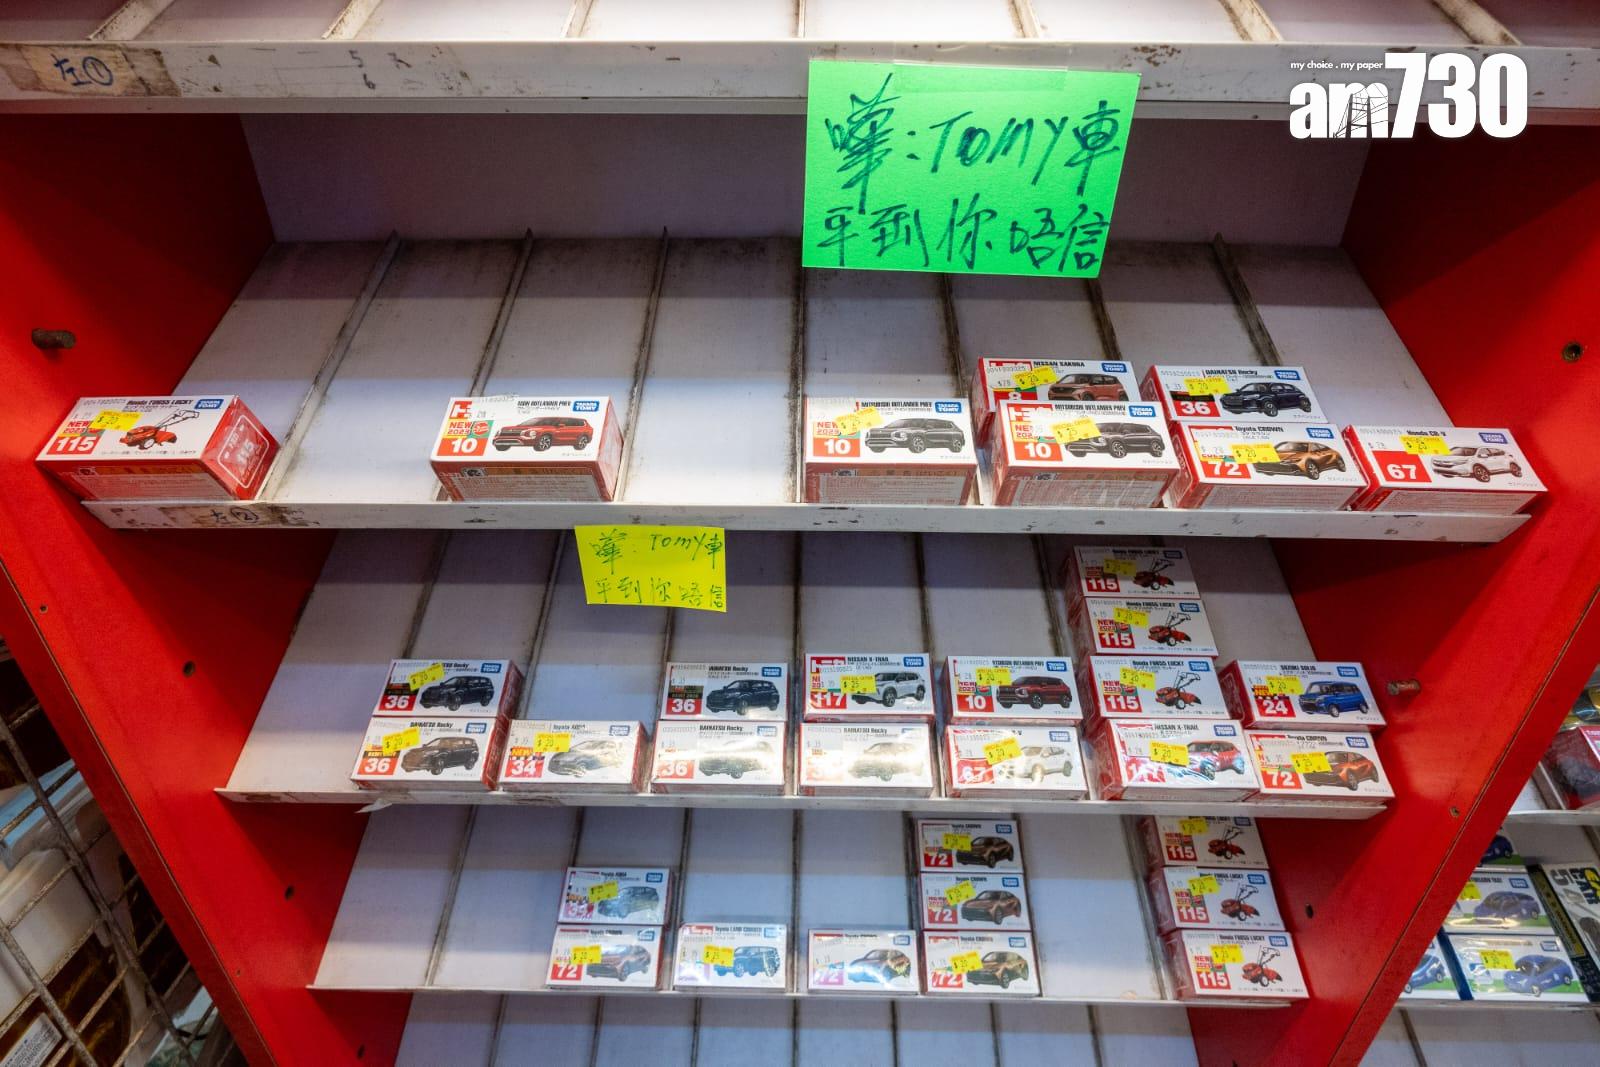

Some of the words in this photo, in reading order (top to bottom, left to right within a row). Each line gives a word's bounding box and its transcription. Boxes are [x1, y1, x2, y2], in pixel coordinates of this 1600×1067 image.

[1180, 401, 1211, 415] 36
[54, 437, 95, 451] 115
[451, 439, 478, 453] 10
[824, 438, 851, 454] 10
[1024, 442, 1052, 458] 10
[1208, 461, 1242, 475] 72
[1386, 463, 1416, 479] 67
[1088, 579, 1117, 590] 115
[1100, 633, 1133, 646] 115
[385, 695, 409, 709] 36
[671, 699, 696, 712] 36
[965, 698, 986, 710] 10
[1106, 696, 1139, 710] 115
[1263, 701, 1288, 715] 24
[364, 758, 389, 772] 36
[512, 760, 537, 775] 34
[661, 761, 688, 776] 36
[1266, 771, 1295, 786] 72
[929, 853, 948, 866] 72
[1169, 846, 1194, 859] 115
[933, 909, 952, 921] 72
[1180, 907, 1206, 921] 115
[556, 963, 576, 977] 72
[1199, 972, 1228, 986] 115
